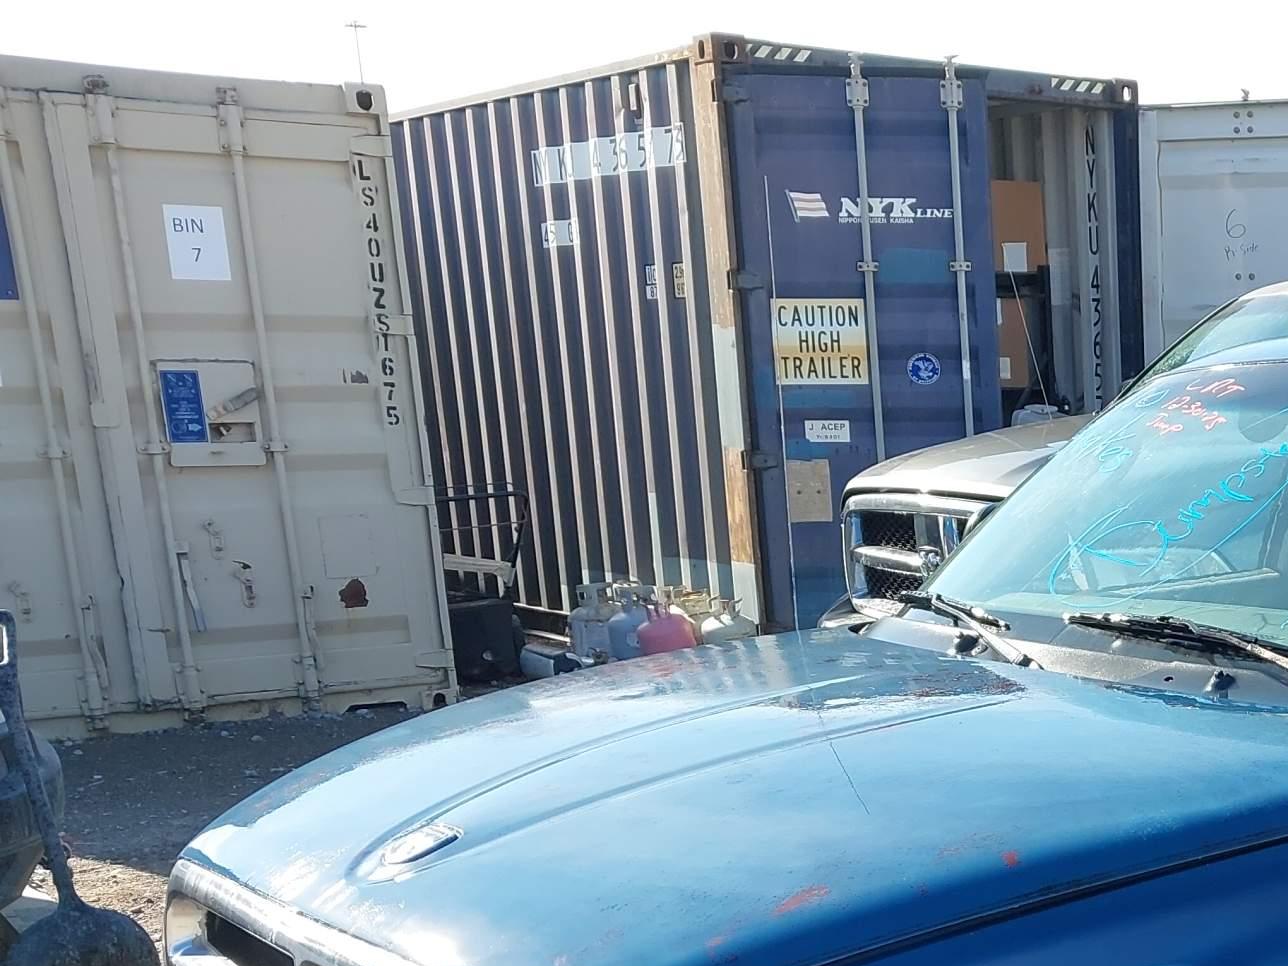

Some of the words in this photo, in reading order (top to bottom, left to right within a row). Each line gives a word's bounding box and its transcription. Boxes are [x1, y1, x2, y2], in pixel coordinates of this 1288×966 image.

[839, 197, 917, 217] NYK
[916, 208, 954, 218] LINE
[172, 217, 204, 234] BIN
[1226, 208, 1247, 239] 6
[191, 247, 202, 263] 7
[777, 304, 860, 328] CAUTION
[798, 330, 842, 353] HIGH
[780, 356, 863, 379] TRAILER
